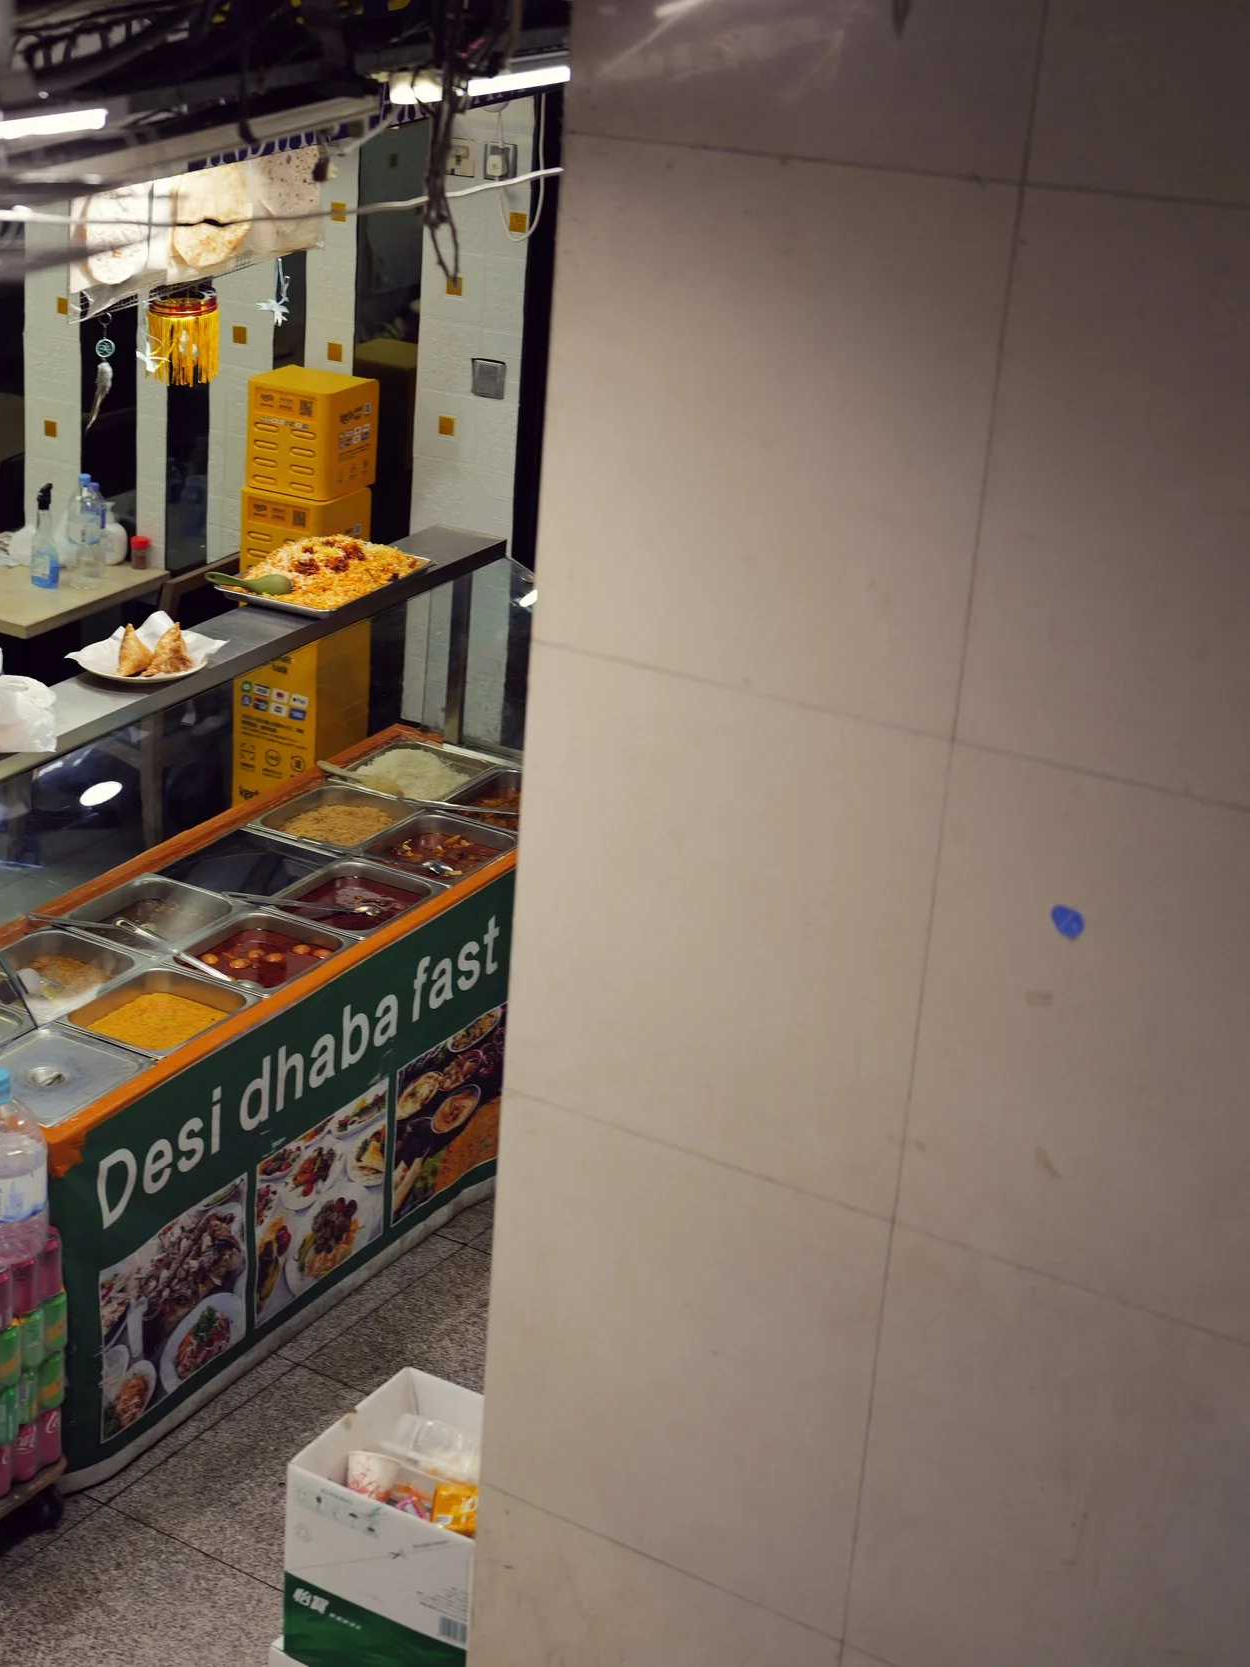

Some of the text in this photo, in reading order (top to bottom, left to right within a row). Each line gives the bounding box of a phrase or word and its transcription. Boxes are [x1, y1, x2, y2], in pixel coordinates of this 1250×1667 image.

[96, 915, 501, 1229] Desi dhaba fast
